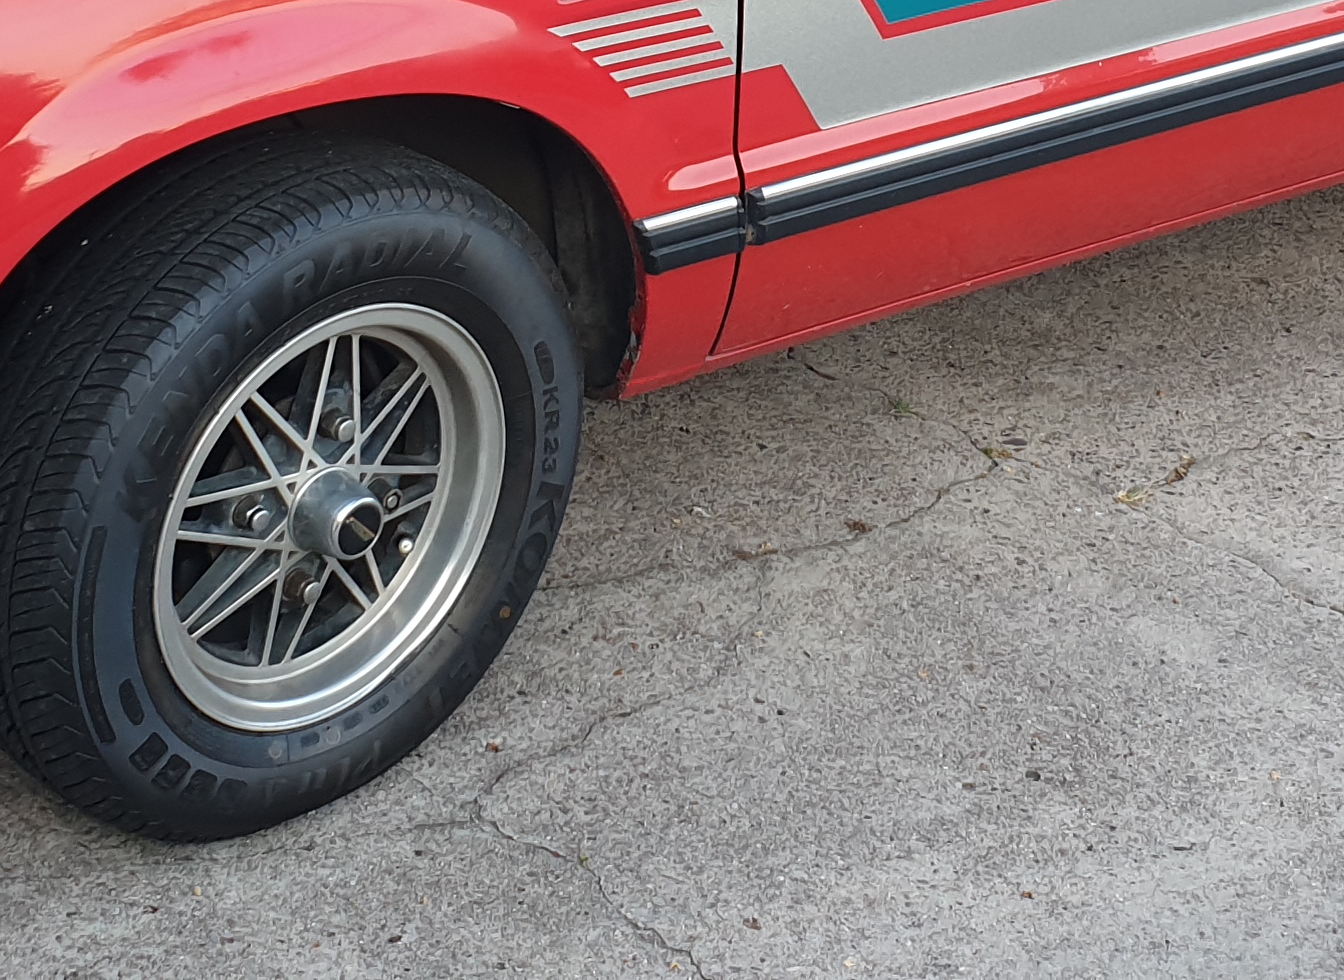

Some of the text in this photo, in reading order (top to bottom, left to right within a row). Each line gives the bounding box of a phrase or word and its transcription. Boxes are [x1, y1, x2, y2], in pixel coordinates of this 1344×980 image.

[115, 226, 473, 525] KENDA RADIAL
[541, 385, 560, 474] KR23
